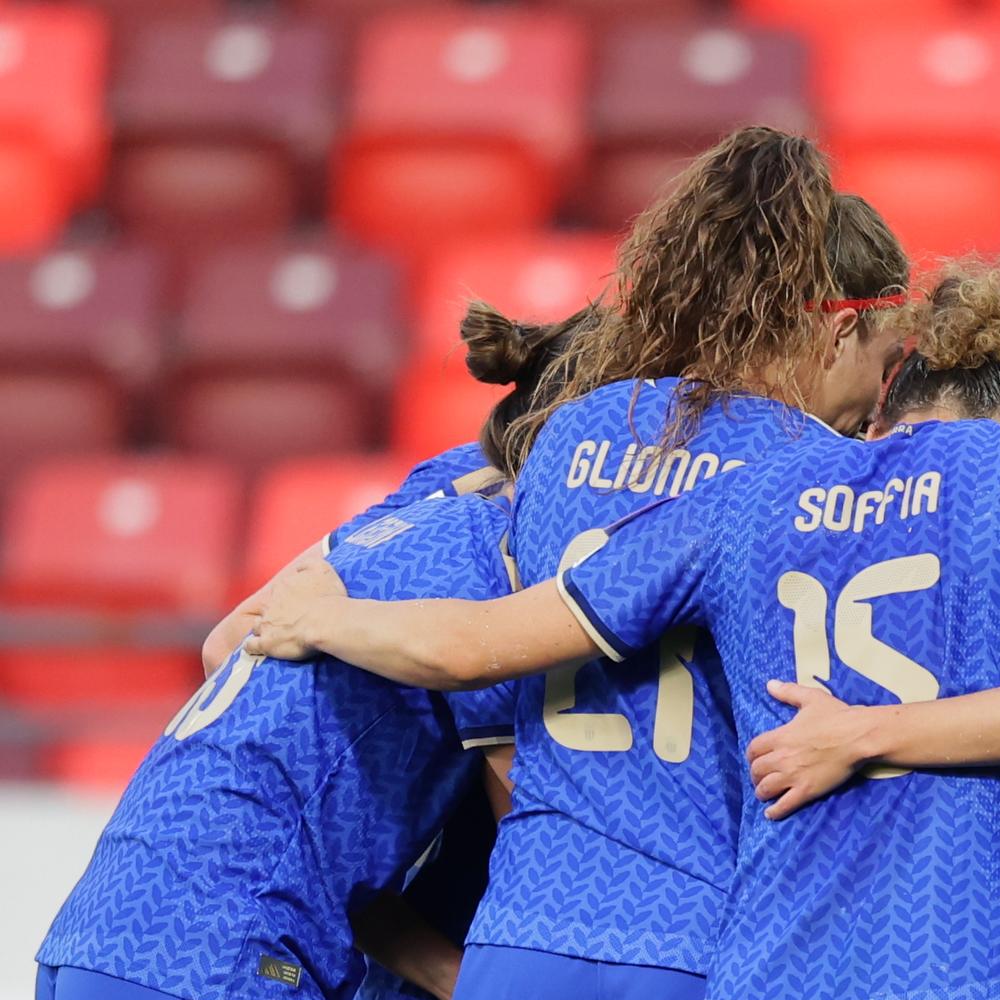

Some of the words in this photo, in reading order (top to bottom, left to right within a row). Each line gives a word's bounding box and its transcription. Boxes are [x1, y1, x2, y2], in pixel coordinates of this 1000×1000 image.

[566, 439, 747, 497] GLIONN
[794, 471, 941, 533] SOFFIA
[776, 552, 941, 779] 15
